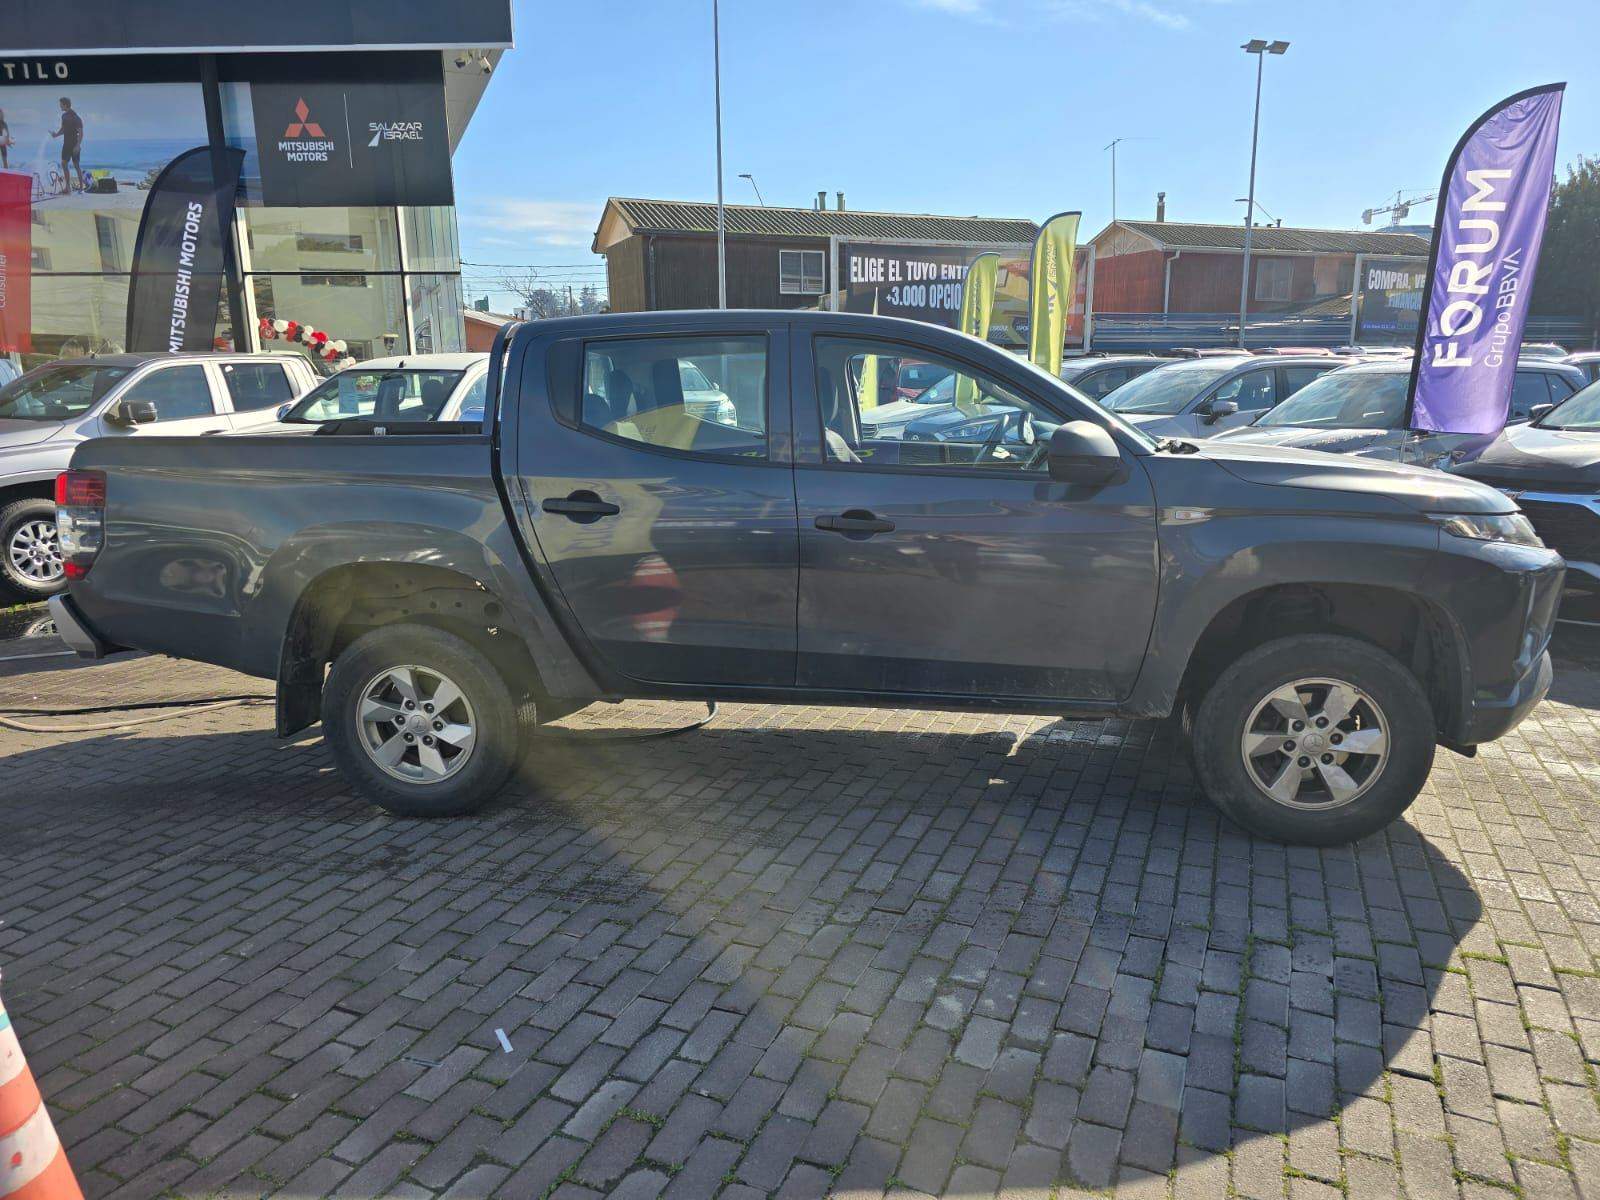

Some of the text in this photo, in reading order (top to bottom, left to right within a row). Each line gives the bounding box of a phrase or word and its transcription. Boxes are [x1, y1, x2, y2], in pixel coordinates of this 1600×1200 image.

[3, 62, 69, 79] TILO
[368, 122, 423, 131] SALAZAR
[383, 131, 423, 140] ISRAEL
[278, 141, 335, 151] MITSUBISHI
[287, 152, 328, 162] MOTORS
[168, 200, 203, 355] MITSUBISHI MOTORS
[850, 256, 885, 283] ELIGE
[888, 259, 903, 282] EL
[905, 261, 937, 281] TUYO
[1368, 268, 1411, 290] COMPRA,
[1431, 169, 1513, 368] FORUM
[886, 283, 963, 310] +3.000 OPCIO
[1484, 247, 1522, 368] Grupo BBVA
